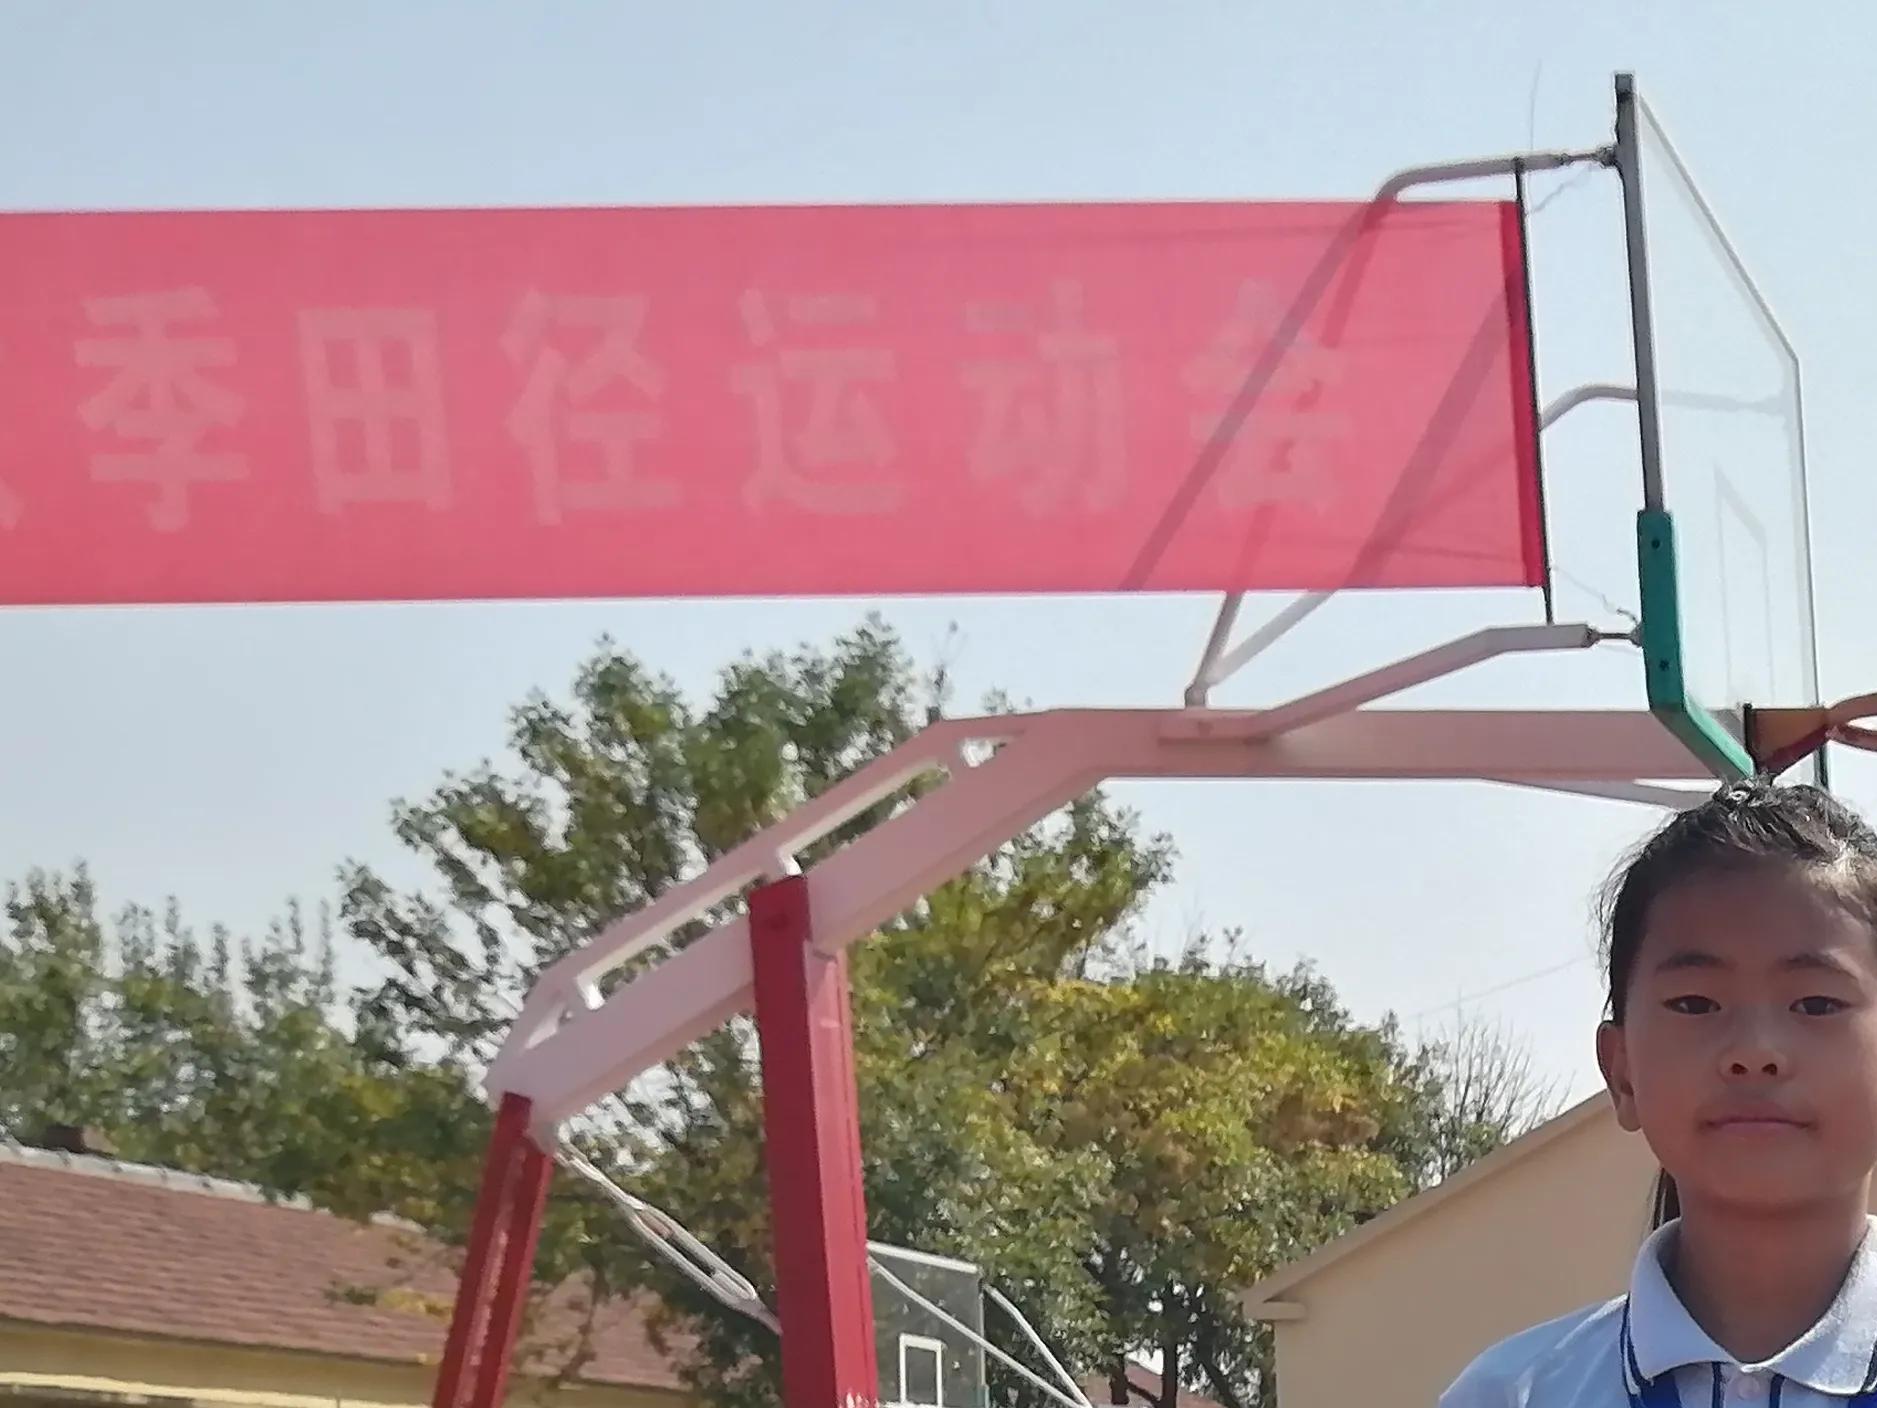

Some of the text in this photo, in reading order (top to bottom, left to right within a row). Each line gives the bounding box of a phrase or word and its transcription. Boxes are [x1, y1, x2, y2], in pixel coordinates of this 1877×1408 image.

[0, 279, 1353, 527] 季田径运动会
